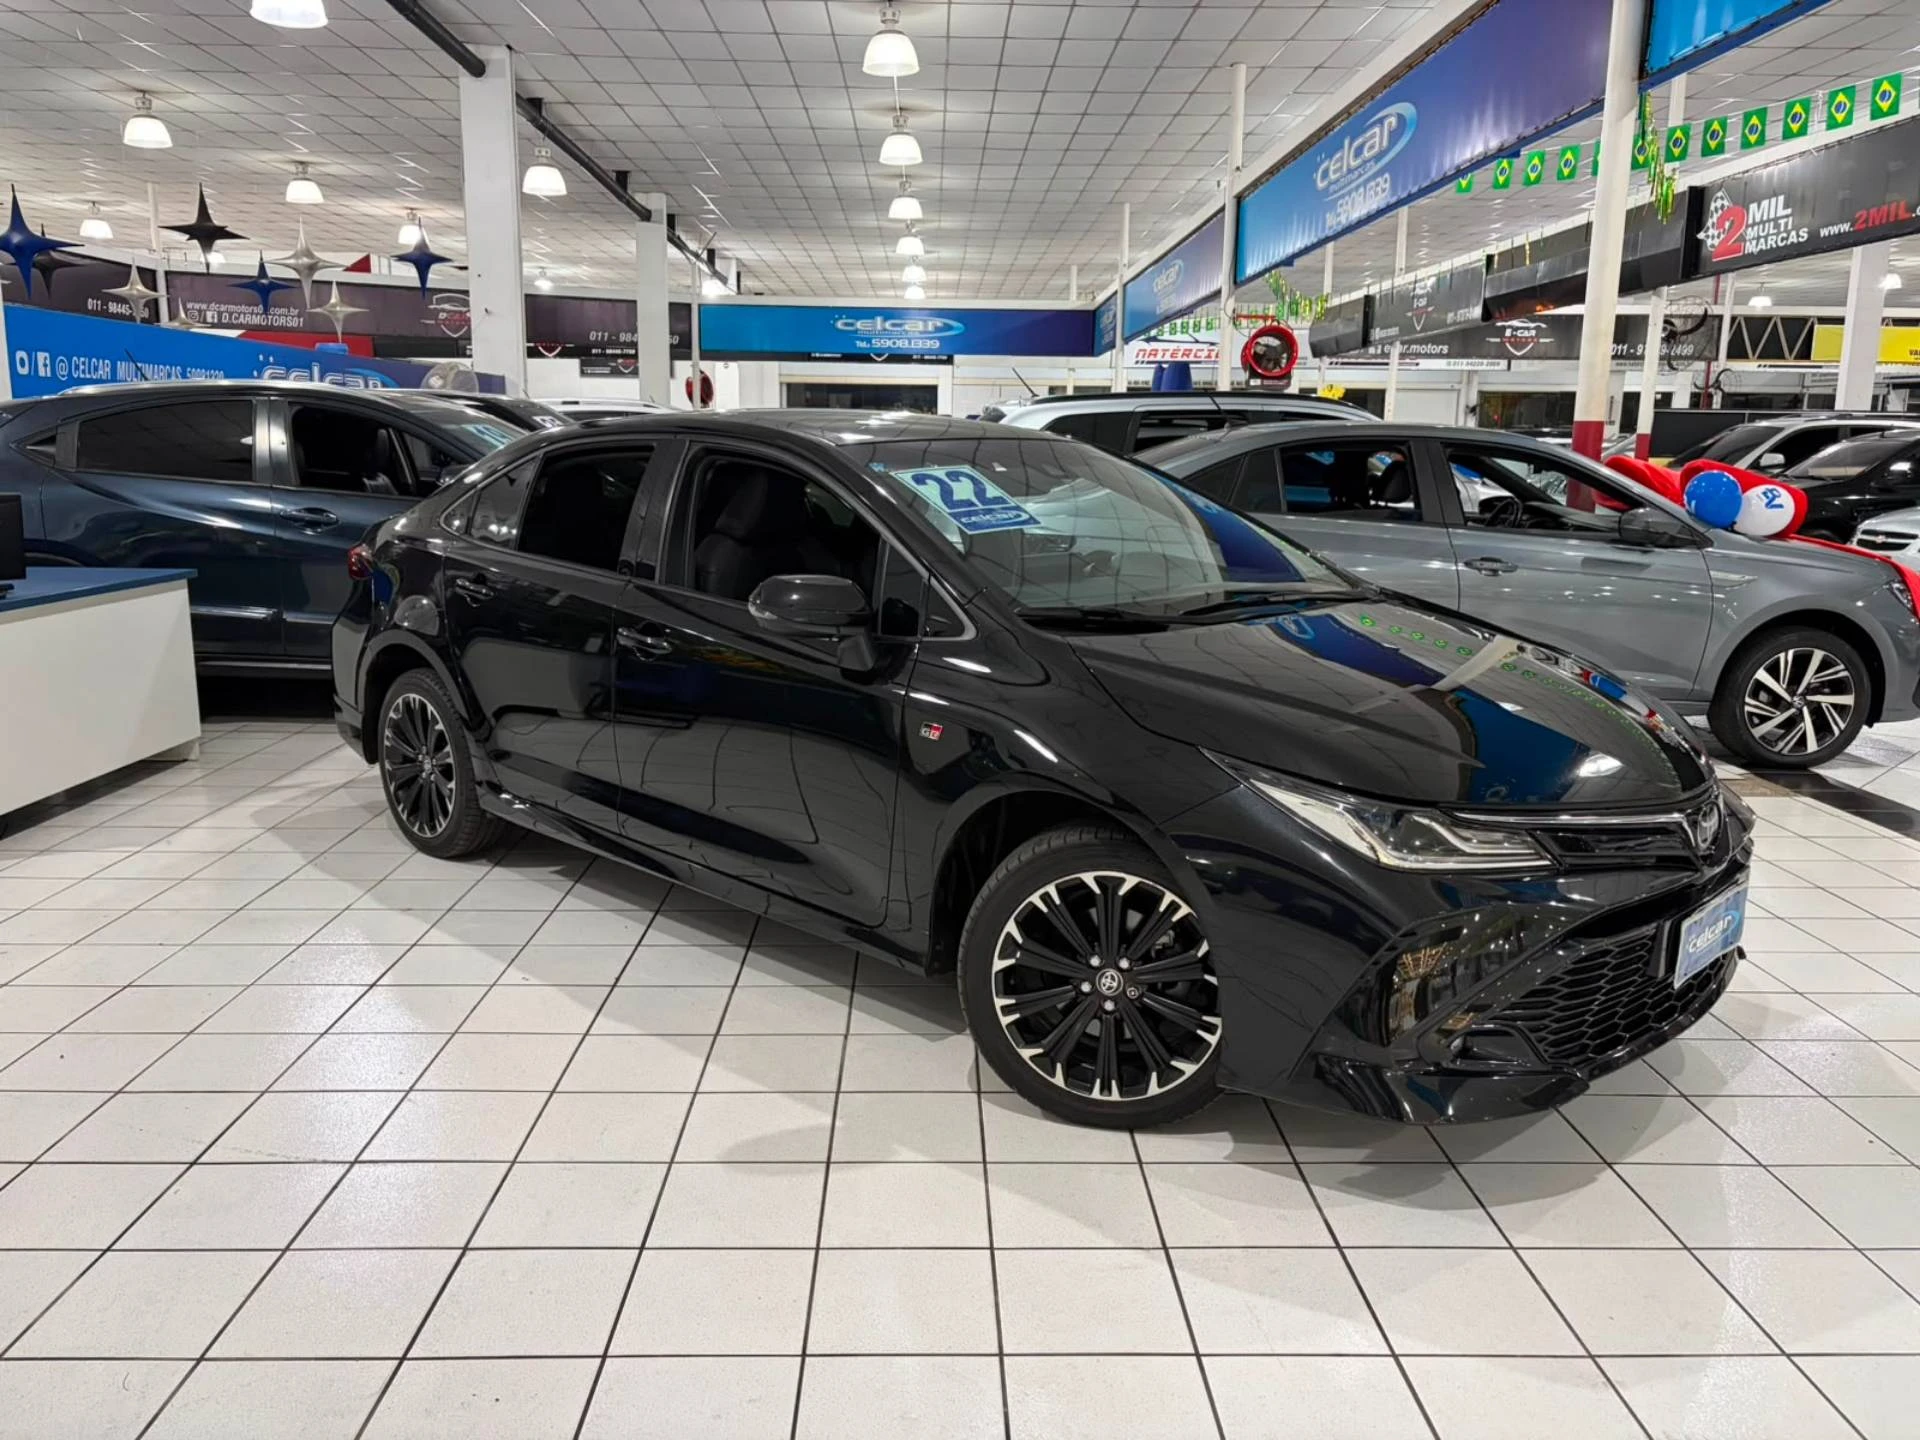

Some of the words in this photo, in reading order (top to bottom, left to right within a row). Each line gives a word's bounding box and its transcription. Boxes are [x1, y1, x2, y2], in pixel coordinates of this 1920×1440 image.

[1316, 112, 1398, 191] celcar
[1748, 194, 1792, 223] MIL
[1746, 216, 1794, 241] MULTI
[1744, 227, 1809, 256] MARCAS
[87, 298, 101, 311] 011
[589, 331, 608, 341] 011
[834, 316, 944, 332] celcar
[1611, 343, 1628, 356] 011
[71, 356, 112, 380] CELCAR
[911, 470, 1010, 511] 22
[1689, 915, 1732, 953] celcar
